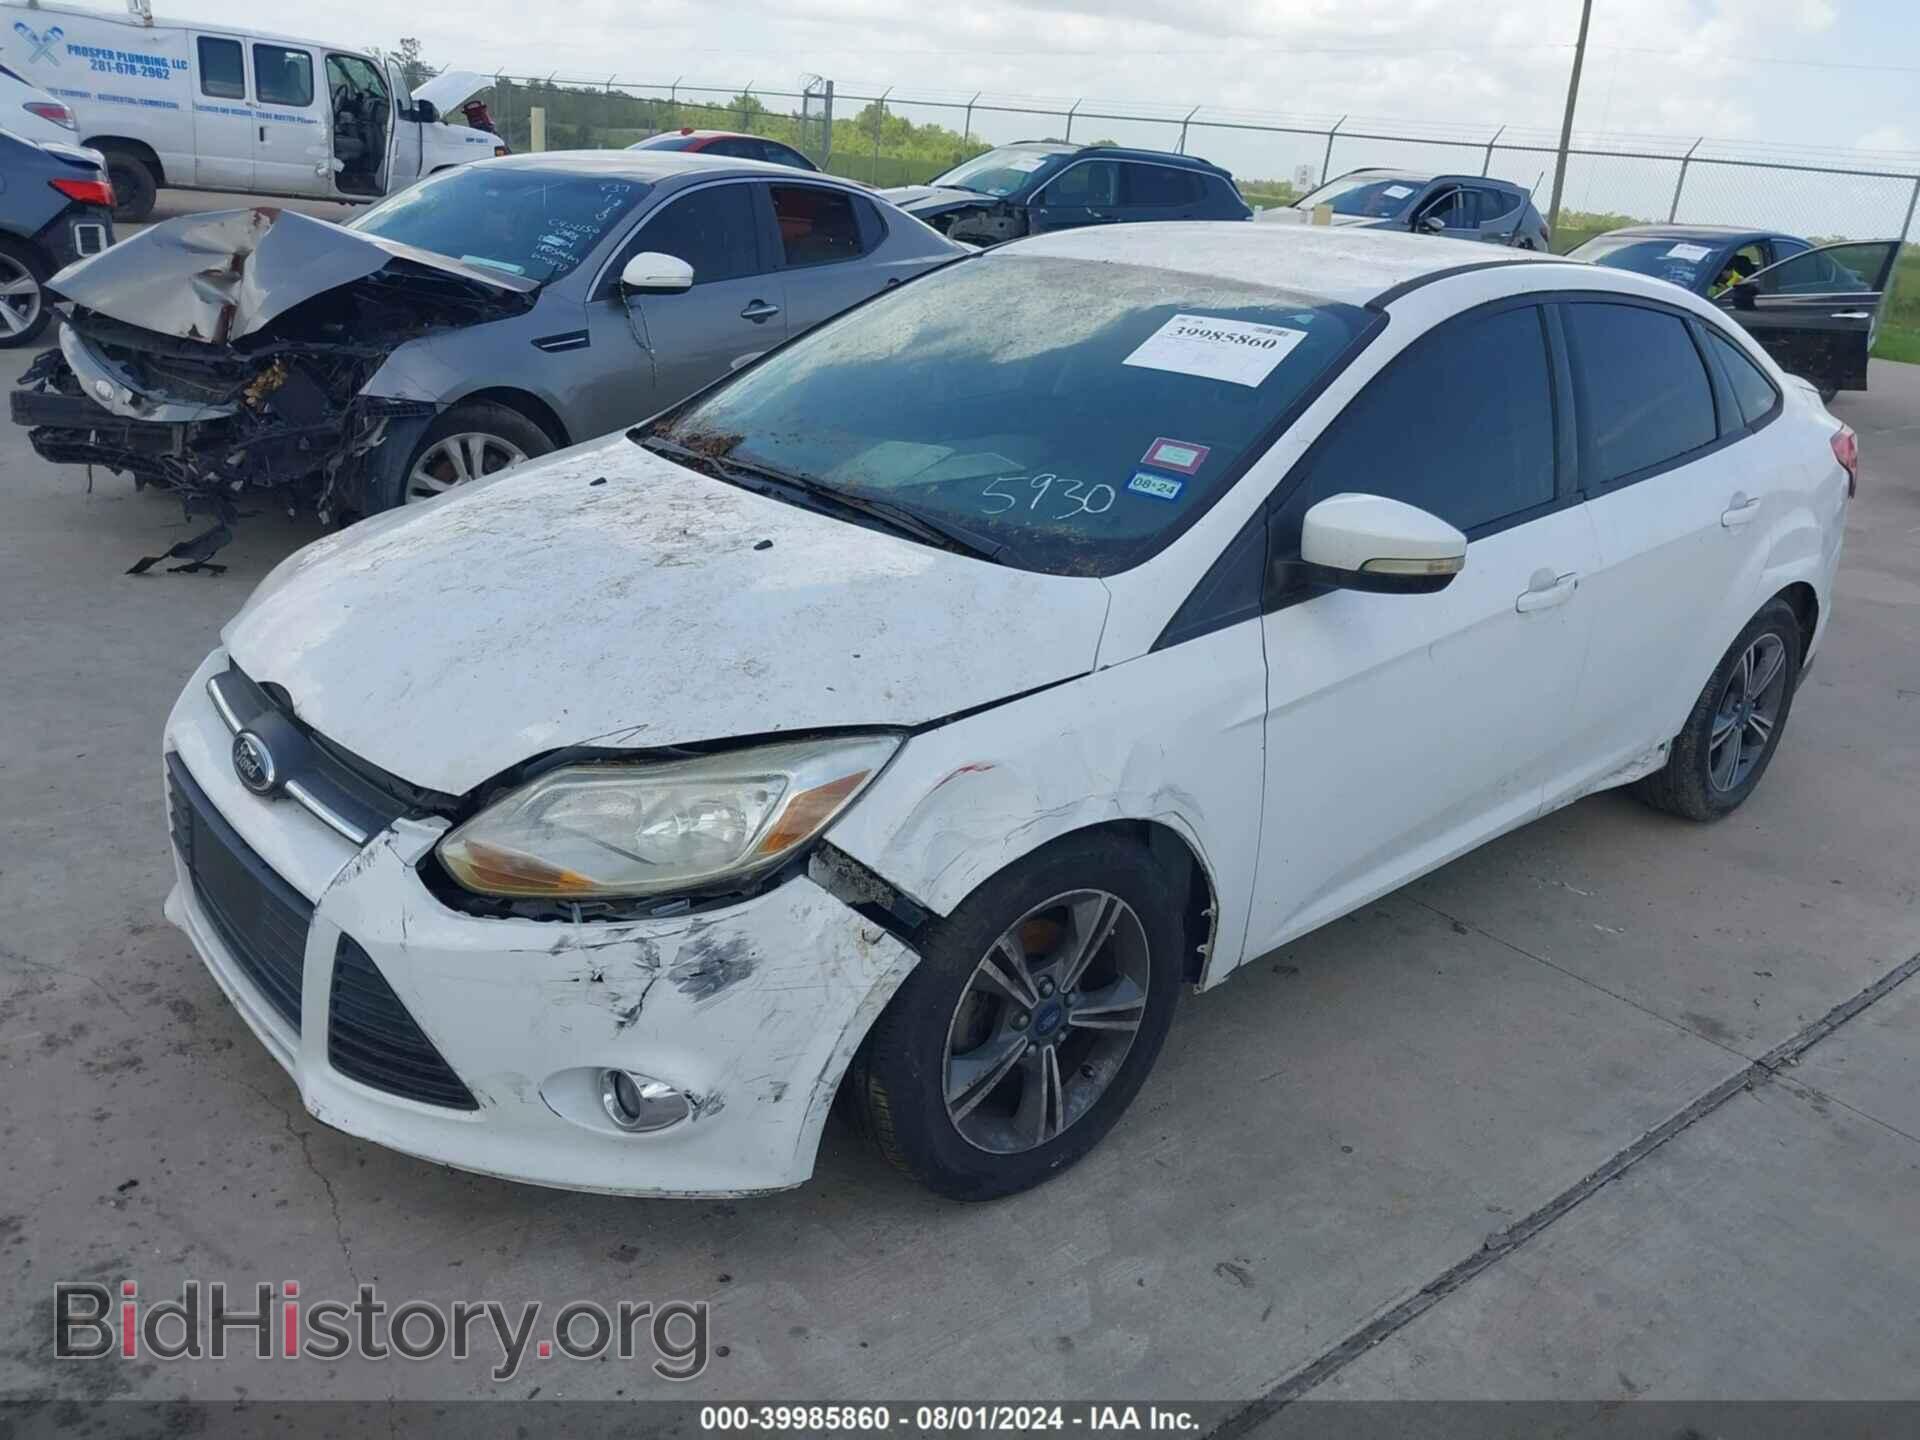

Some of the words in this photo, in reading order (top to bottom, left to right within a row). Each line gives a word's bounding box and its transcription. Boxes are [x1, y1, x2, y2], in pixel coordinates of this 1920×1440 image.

[66, 44, 114, 61] PROSPER
[172, 59, 188, 71] LLC
[90, 59, 170, 80] 281-678-2962
[1173, 326, 1278, 350] 39985860
[982, 473, 1116, 520] 5930
